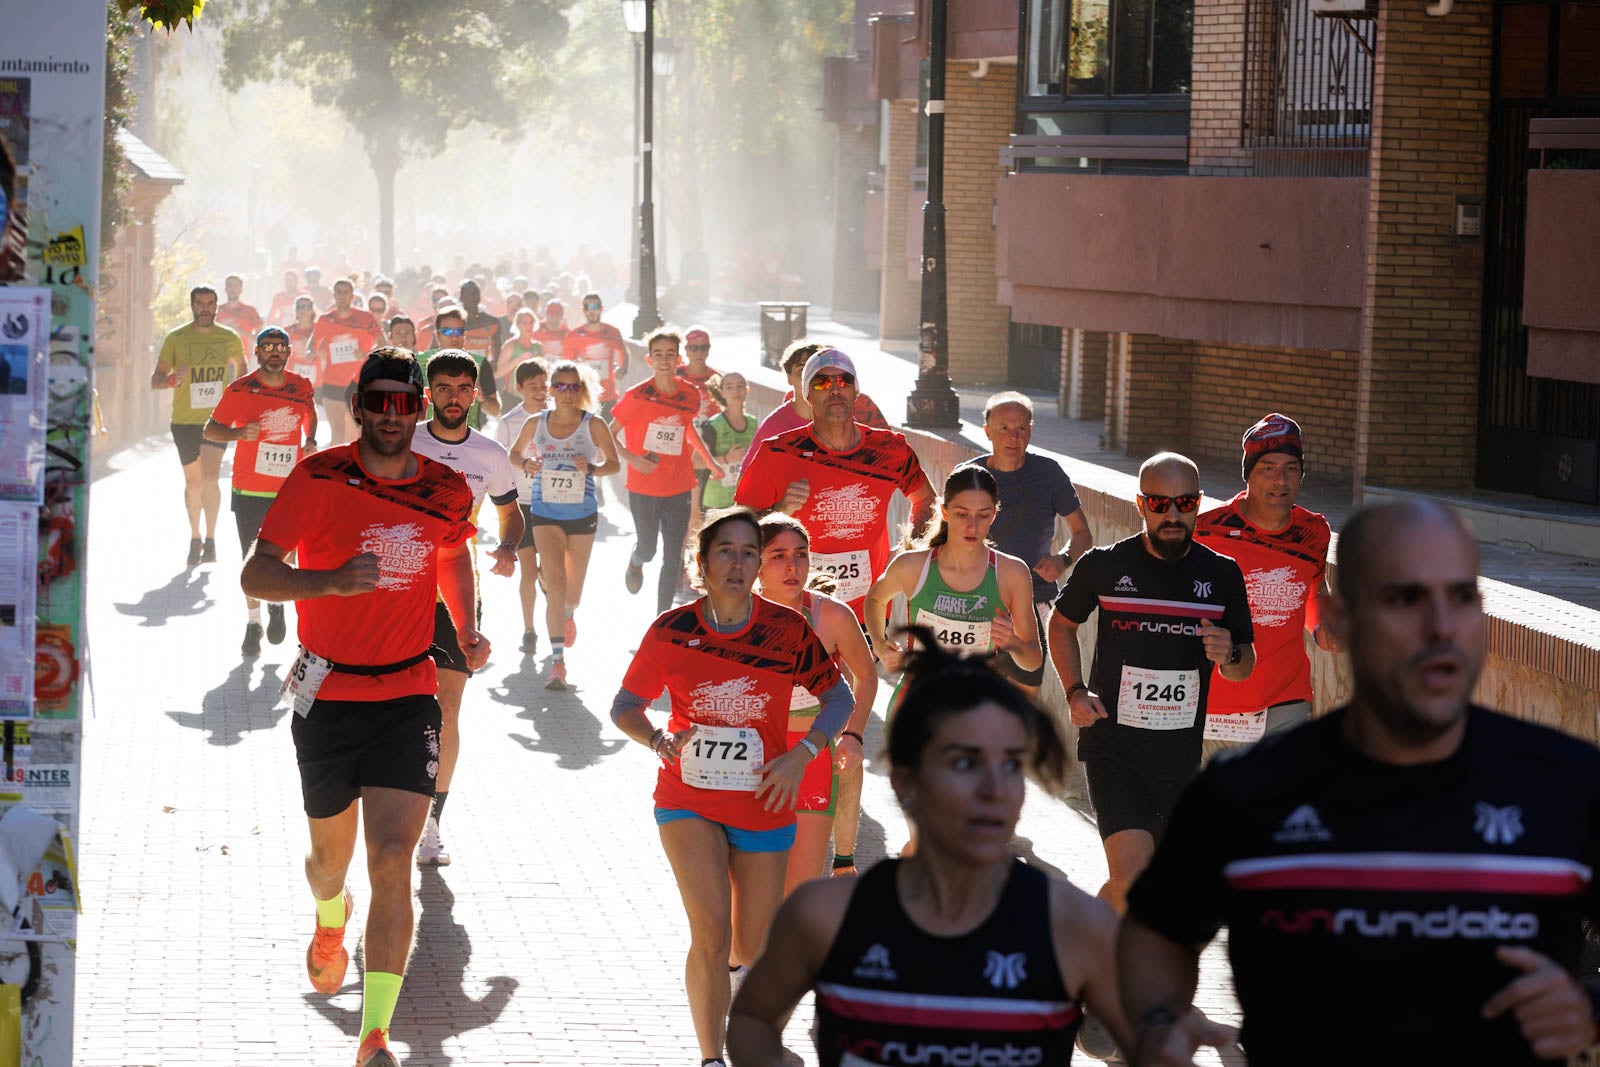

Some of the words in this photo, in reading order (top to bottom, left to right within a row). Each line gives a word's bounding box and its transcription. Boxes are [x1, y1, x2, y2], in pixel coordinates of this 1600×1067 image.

[198, 388, 215, 396] 760
[656, 431, 675, 441] 592
[264, 451, 292, 463] 1119
[551, 477, 573, 489] 773
[817, 499, 875, 511] carrera
[362, 540, 427, 557] carrera
[381, 556, 423, 570] zroja.es
[1245, 583, 1301, 597] carrera
[933, 594, 968, 614] ATARFE
[1249, 597, 1301, 607] ruzroja.es
[1111, 618, 1204, 636] runrundat
[1132, 682, 1186, 702] 1246
[692, 698, 764, 711] carrera
[693, 738, 748, 761] 1772
[1263, 905, 1540, 940] runrundato
